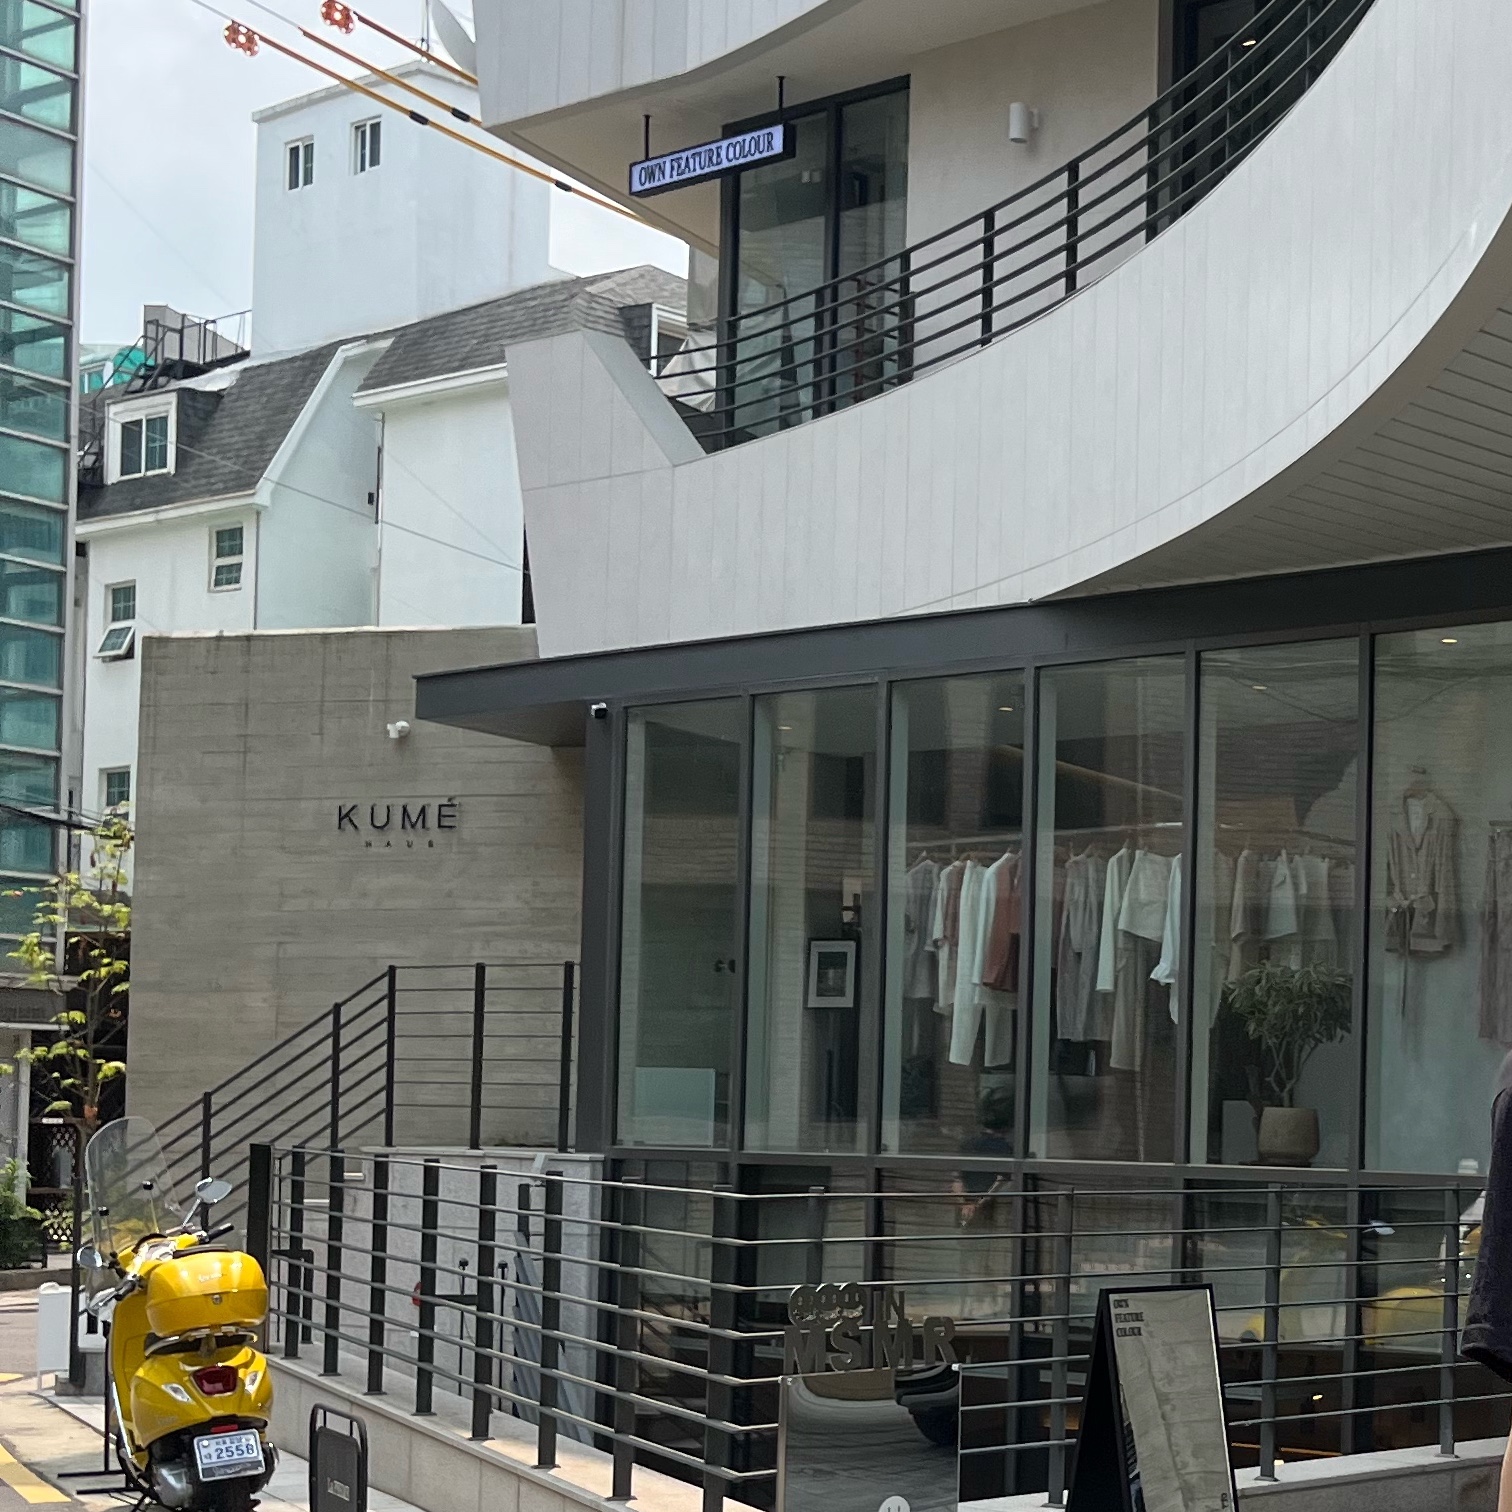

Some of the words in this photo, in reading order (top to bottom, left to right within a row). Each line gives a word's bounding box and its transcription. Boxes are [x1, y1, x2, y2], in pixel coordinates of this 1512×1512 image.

[638, 160, 667, 187] OWN
[669, 145, 723, 180] FEATURE
[725, 131, 775, 163] COLOUR
[337, 796, 458, 830] KUMÉ
